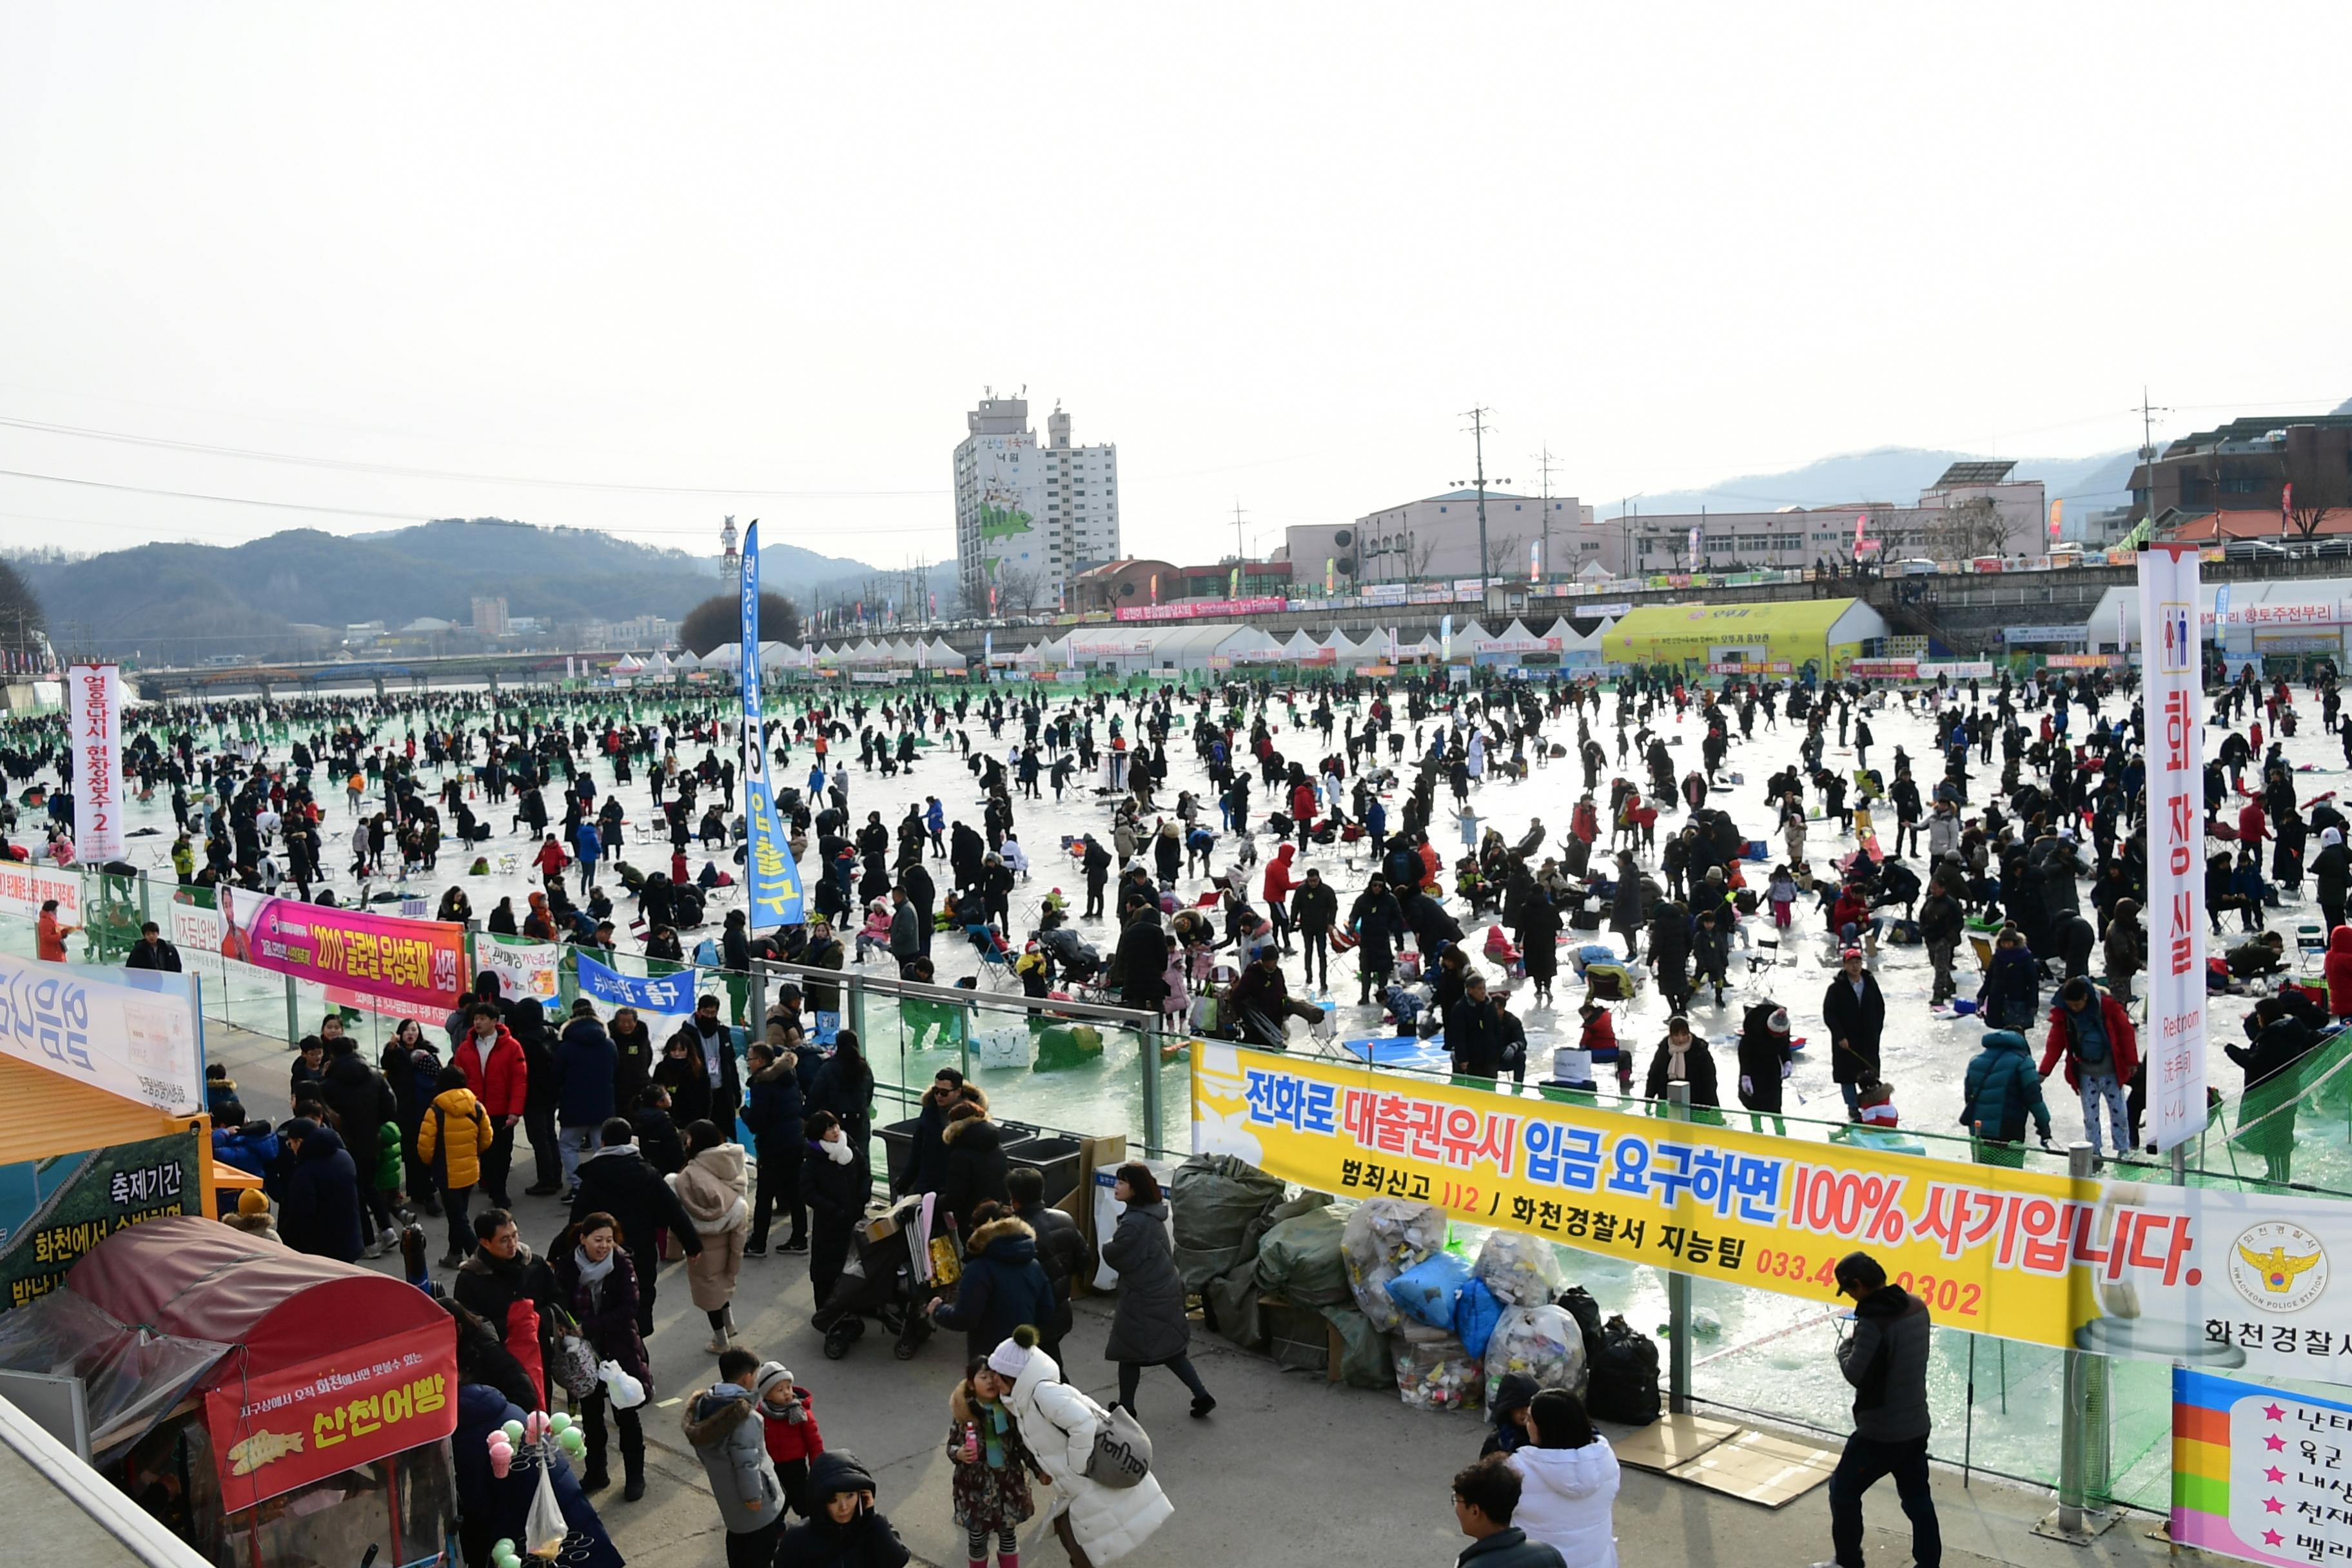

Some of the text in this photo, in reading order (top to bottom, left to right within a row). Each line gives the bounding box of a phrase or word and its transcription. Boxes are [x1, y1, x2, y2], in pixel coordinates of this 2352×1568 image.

[1252, 600, 1279, 612] Fishing
[2245, 605, 2331, 623] 향토주전부리
[83, 676, 110, 740] 얼음낚시
[749, 725, 761, 774] 5
[86, 745, 112, 808] 현장접수
[93, 814, 108, 832] 2
[2165, 691, 2192, 976] 화장실
[344, 930, 380, 981] 글로벌
[435, 948, 456, 992] 선정
[493, 946, 522, 968] 판매장
[2164, 1099, 2186, 1126] トイレ
[112, 1162, 182, 1204] 축제기간
[1245, 1070, 2202, 1286] 전화로 대출권유시 입금 요구하면 100% 사기입니다.
[1341, 1159, 1430, 1200] 범죄신고
[1442, 1182, 1479, 1213] 112
[1511, 1196, 1646, 1249] 화천경찰서
[1658, 1224, 1746, 1269] 지능팀
[35, 1219, 107, 1263] 화천에서
[2244, 1224, 2316, 1249] 화천경찰서
[2233, 1266, 2324, 1309] HWACHEON POLICE STATION
[240, 1393, 293, 1418] 지구상에서
[295, 1386, 315, 1404] 오직
[315, 1369, 371, 1393] 화천에서만
[403, 1352, 423, 1367] 있는
[313, 1373, 446, 1449] 산천어빵
[2299, 1439, 2342, 1470] 육군
